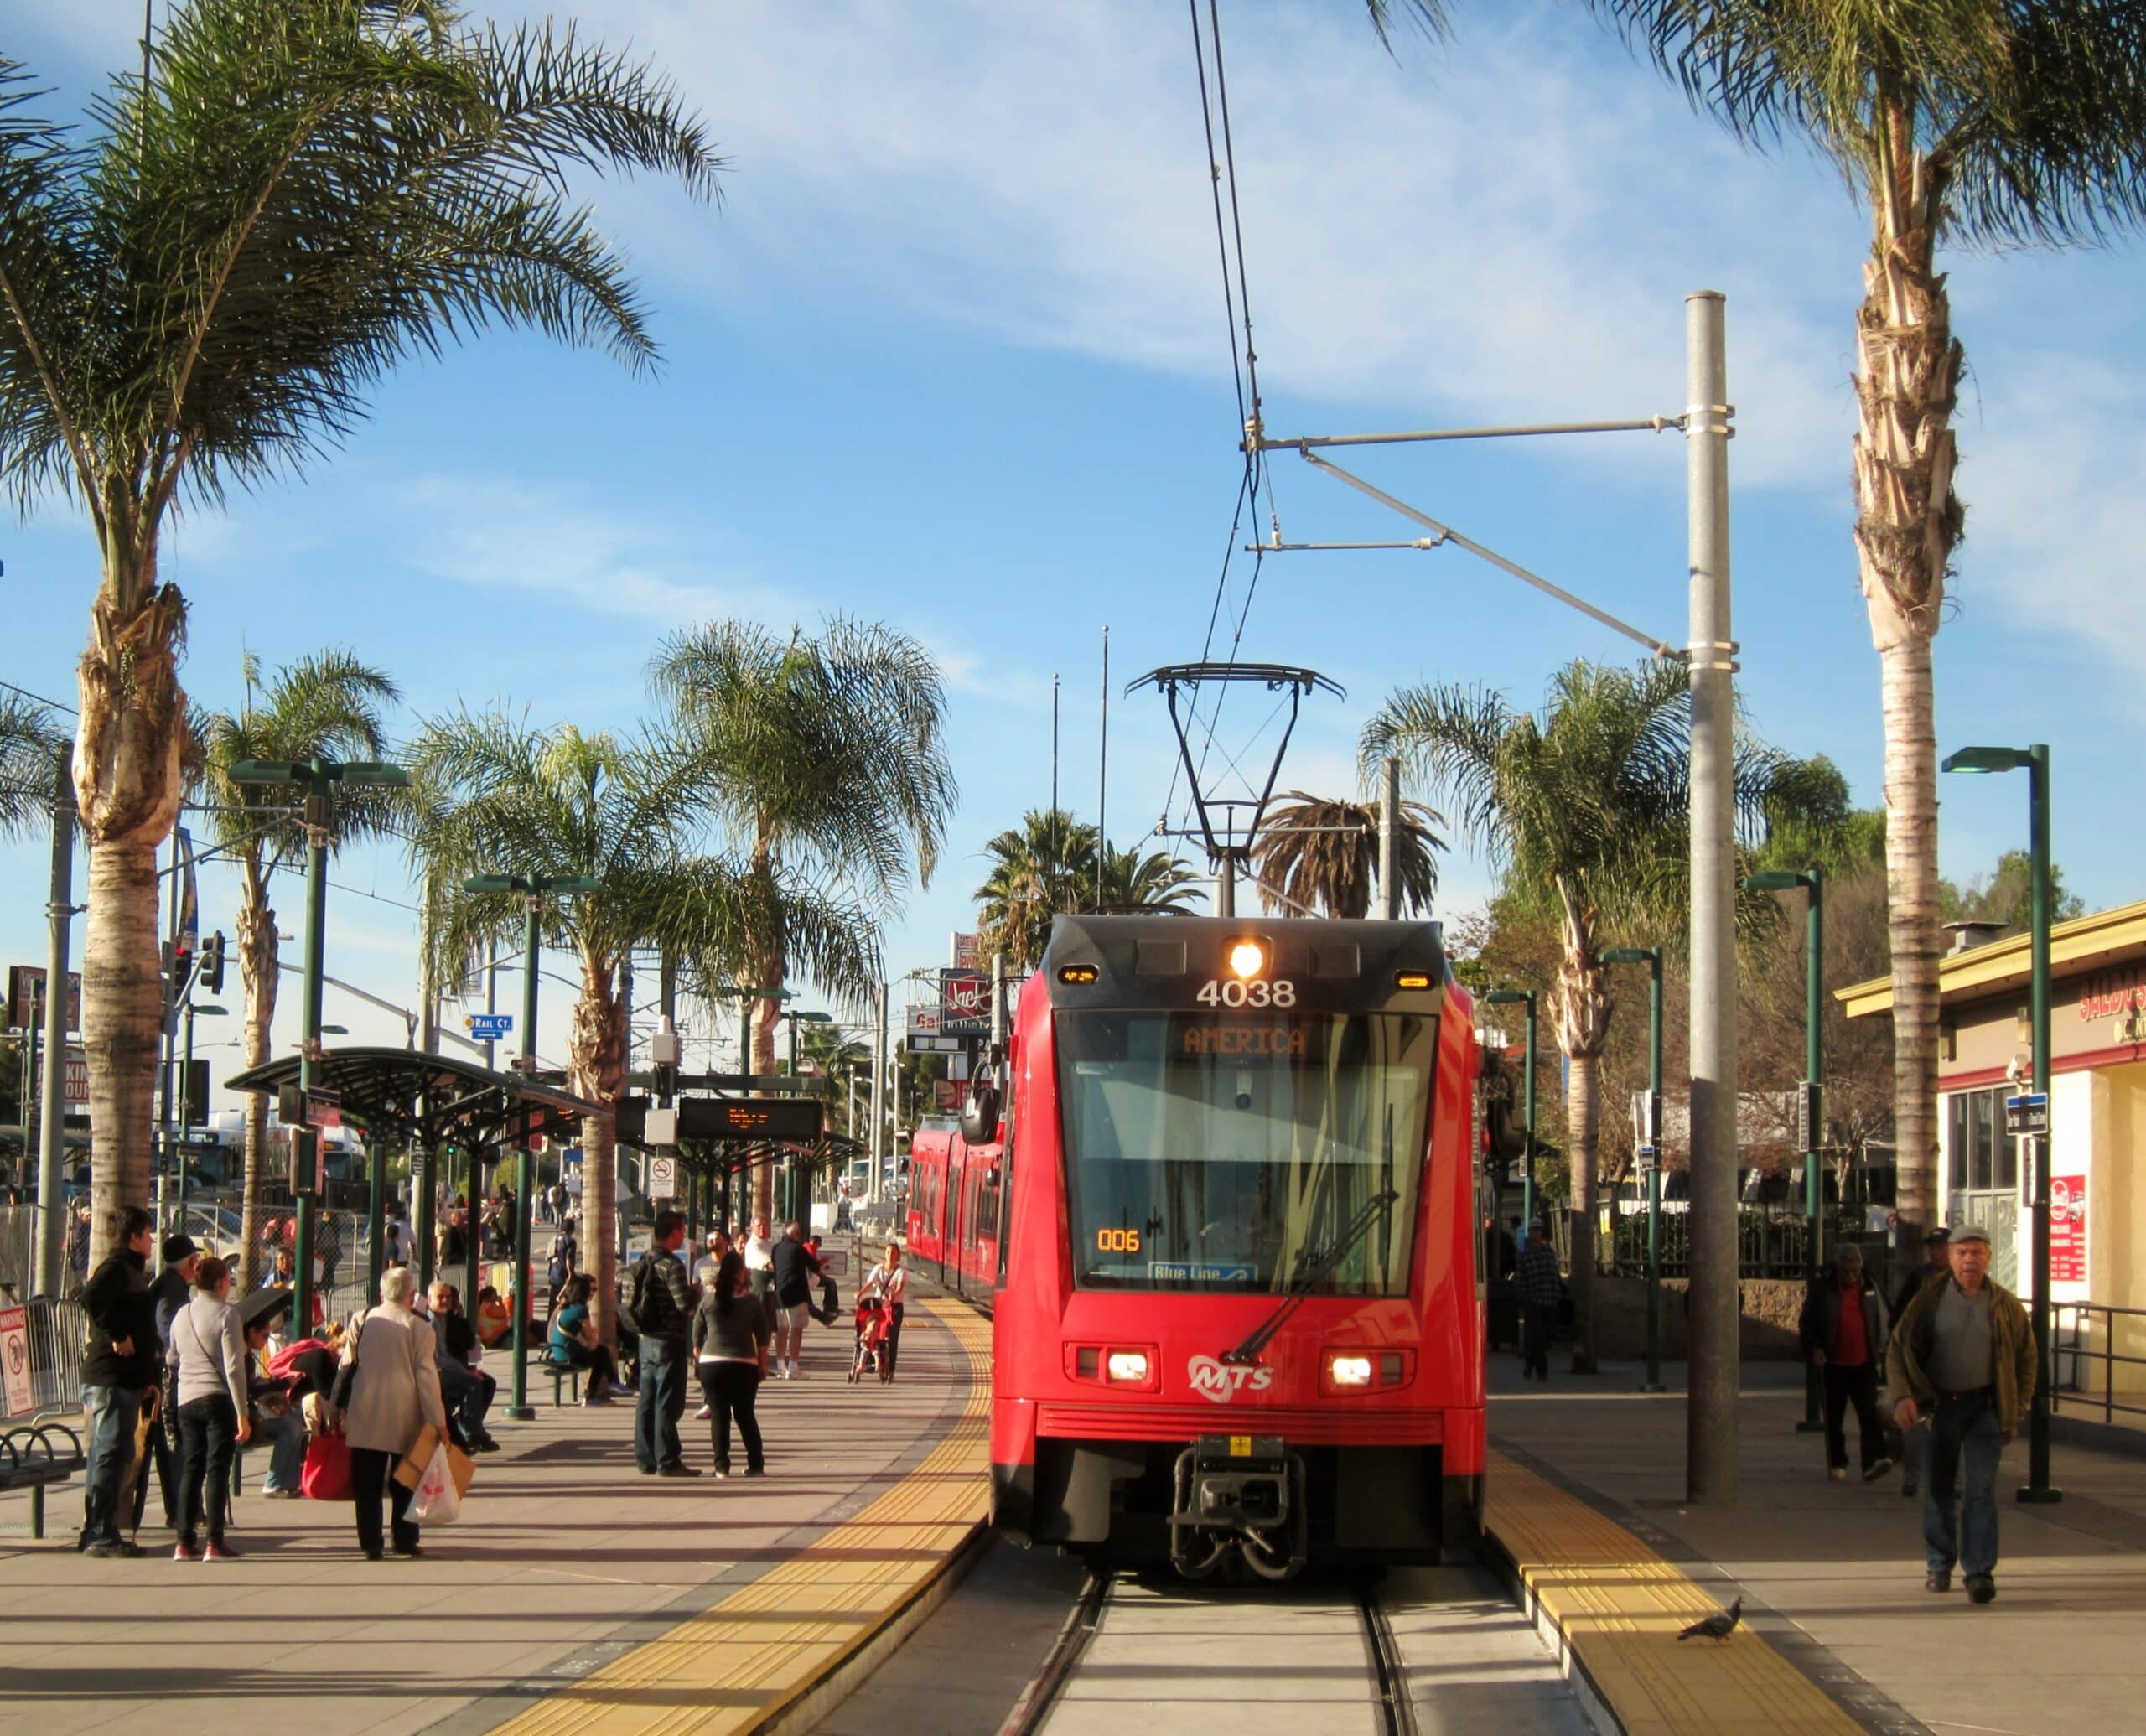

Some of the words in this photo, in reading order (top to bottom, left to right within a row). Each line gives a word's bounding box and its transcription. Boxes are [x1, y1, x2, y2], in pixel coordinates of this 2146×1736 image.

[1196, 979, 1297, 1008] 4038
[1184, 1027, 1306, 1054] AMERICA
[1097, 1229, 1140, 1252] 006
[1154, 1265, 1187, 1280] Blue
[1190, 1266, 1221, 1281] Line
[1188, 1365, 1275, 1391] MTS
